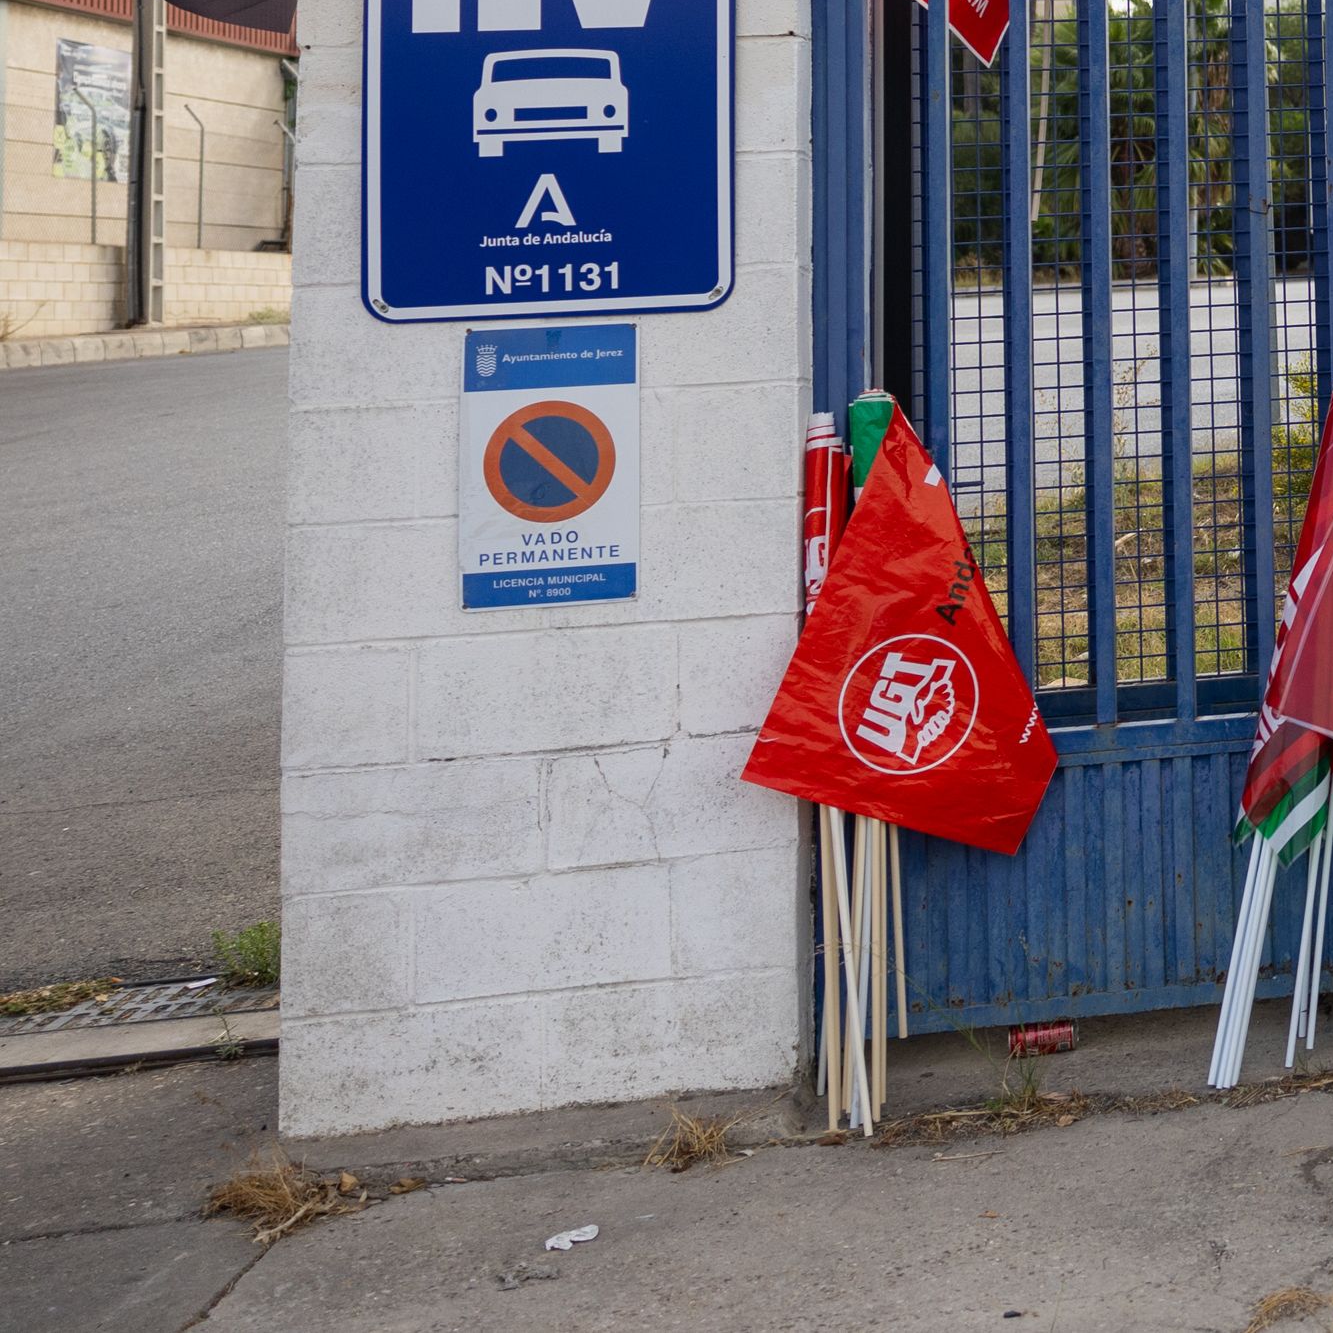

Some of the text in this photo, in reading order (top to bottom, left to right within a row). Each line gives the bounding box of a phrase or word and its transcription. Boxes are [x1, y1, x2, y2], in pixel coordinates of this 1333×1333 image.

[479, 228, 613, 248] Junta de Andalucía
[501, 347, 624, 364] Ayuntamiento de Jerez
[521, 530, 579, 547] VADO
[479, 544, 621, 567] PERMANENTE
[493, 572, 607, 589] LICENCIA MUNICIPAL
[546, 587, 572, 598] 8900
[855, 651, 938, 754] UGT
